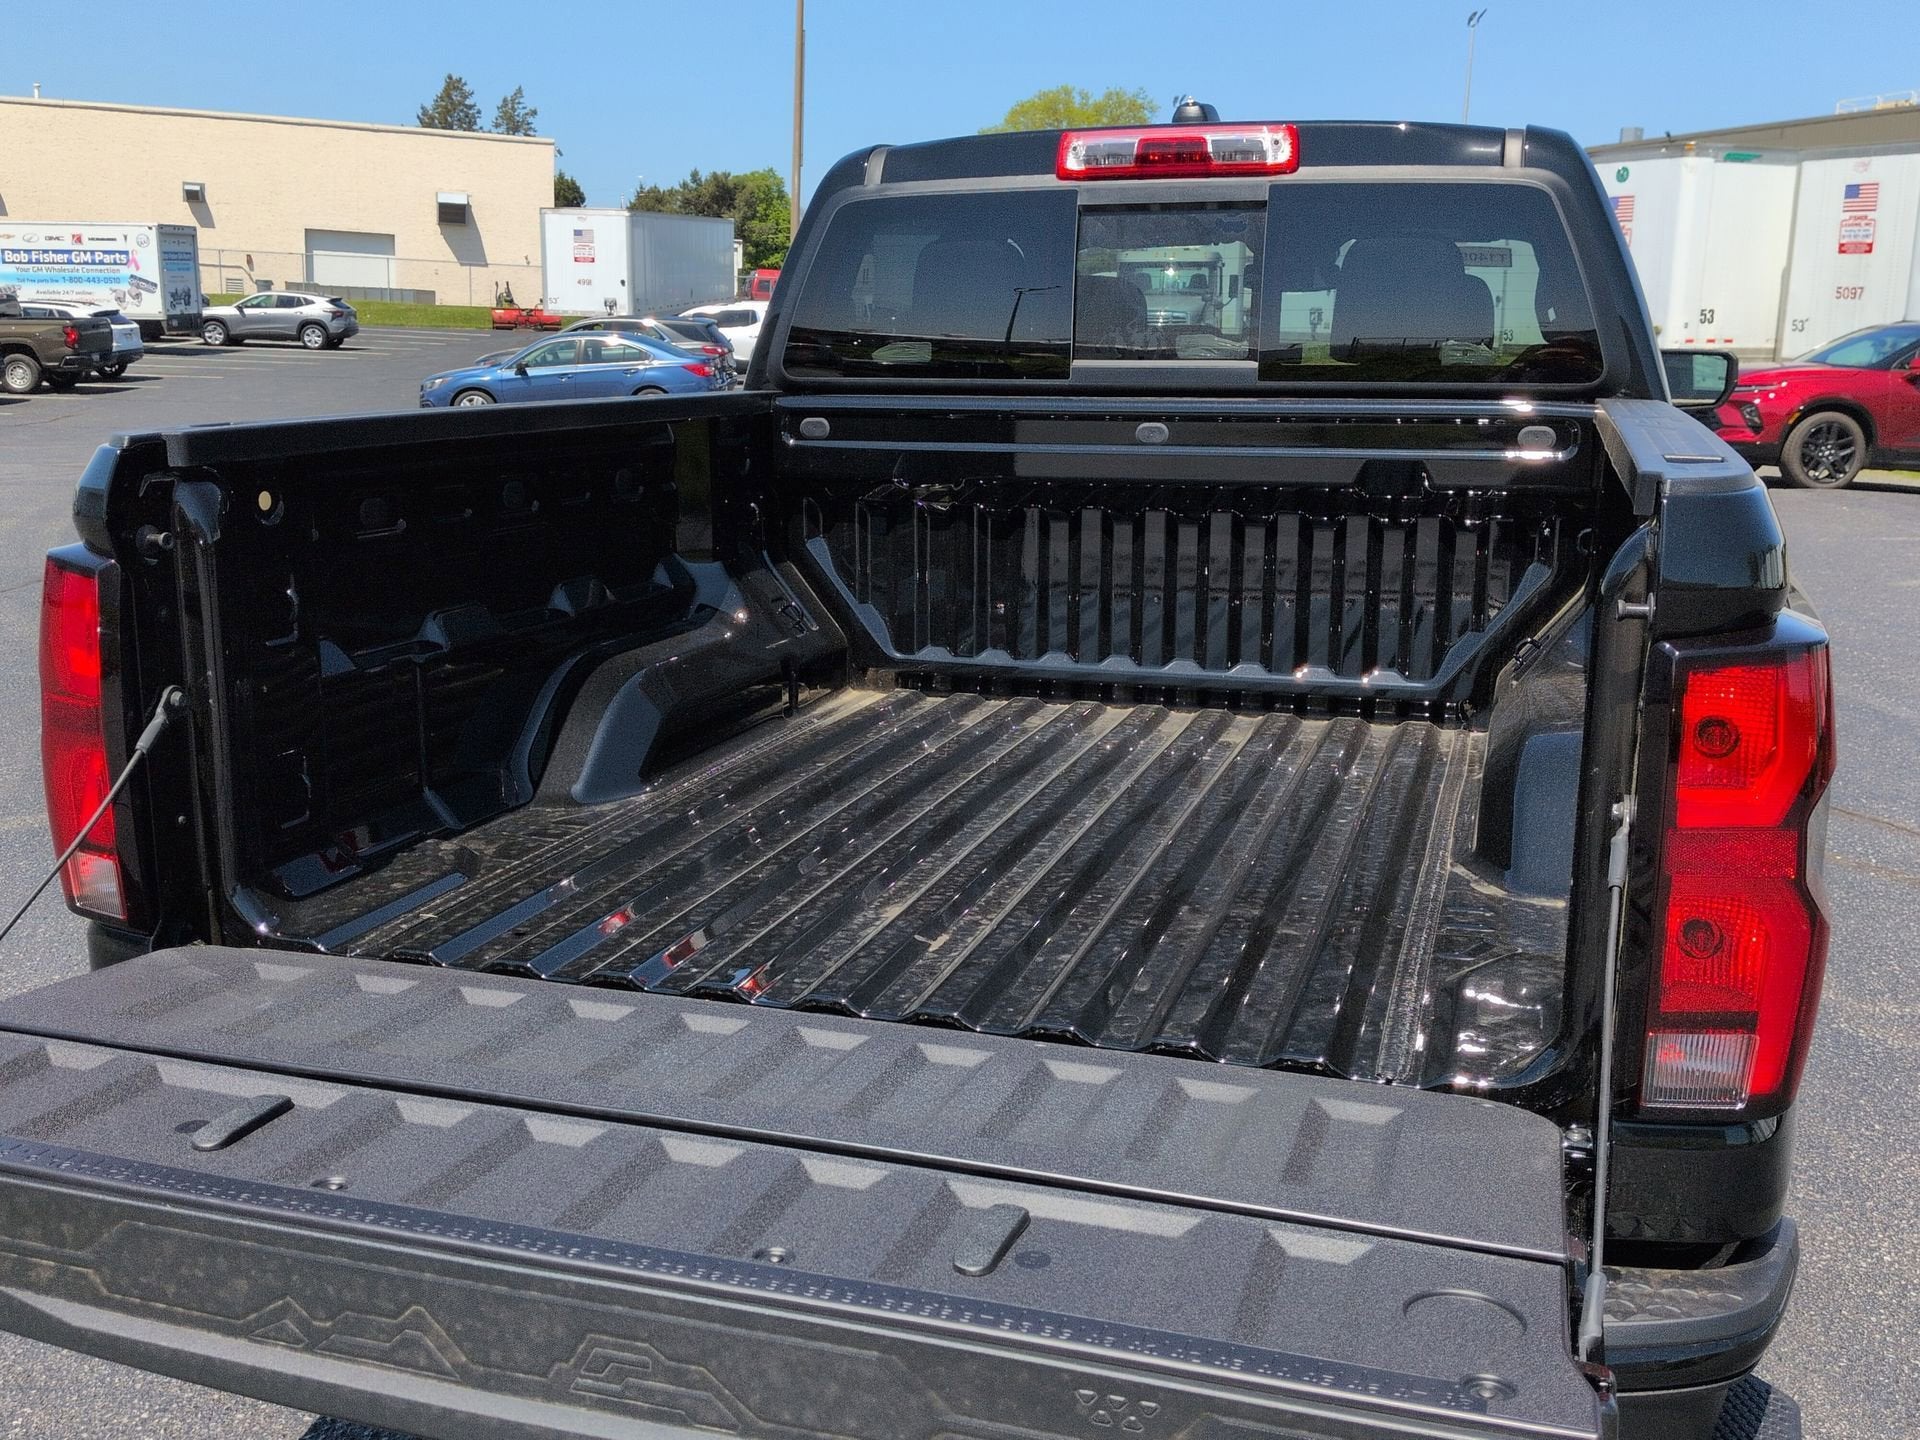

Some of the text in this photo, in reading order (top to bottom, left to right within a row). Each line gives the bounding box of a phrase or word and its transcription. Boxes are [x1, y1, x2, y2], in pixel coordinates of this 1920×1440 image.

[4, 250, 127, 264] Bob Fisher GM Parts
[62, 276, 121, 284] 1-800-443-0510
[1835, 286, 1864, 300] 5097
[1700, 308, 1715, 324] 53
